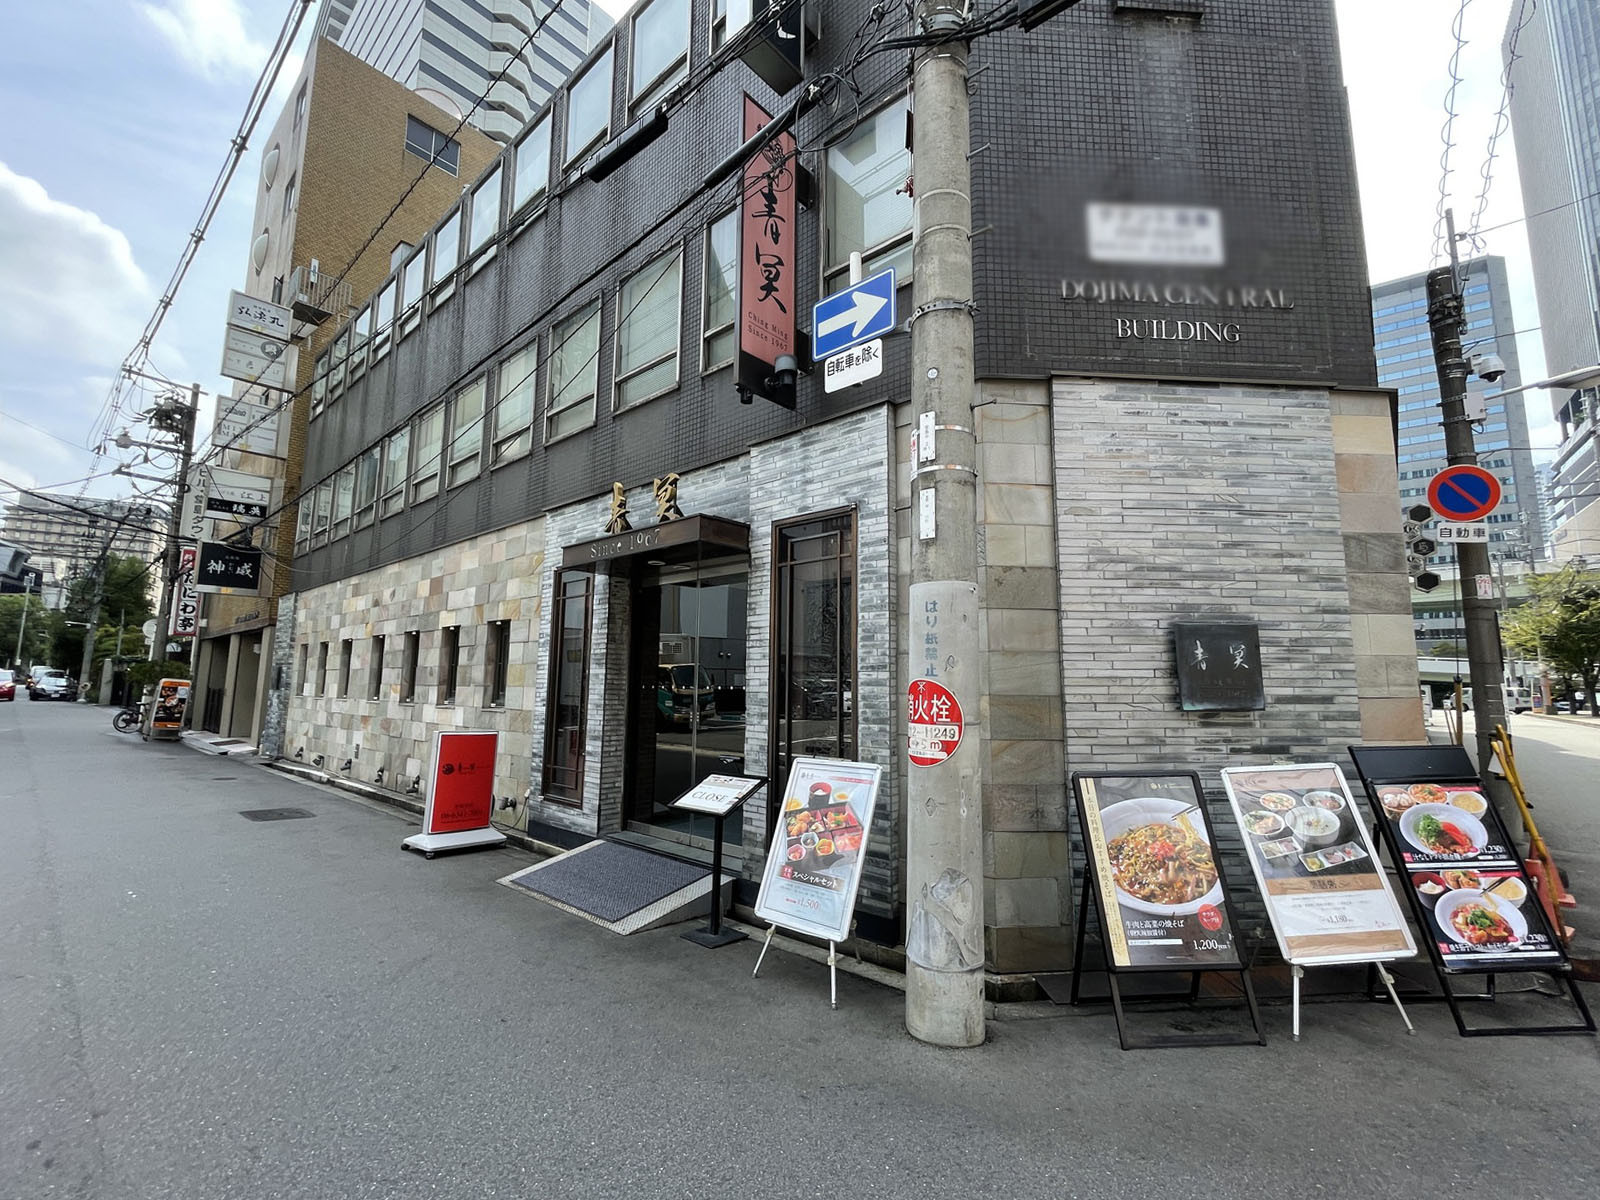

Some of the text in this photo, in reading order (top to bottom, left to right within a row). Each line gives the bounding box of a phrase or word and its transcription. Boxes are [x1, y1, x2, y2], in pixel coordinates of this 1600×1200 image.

[1060, 279, 1158, 303] DOJIMA
[1115, 318, 1241, 343] BUILDING
[827, 345, 879, 377] 自転車を除く
[1439, 527, 1487, 539] 自動車
[590, 542, 622, 559] Since
[924, 600, 939, 677] はり紙禁止
[792, 871, 838, 888] スペシャルセット
